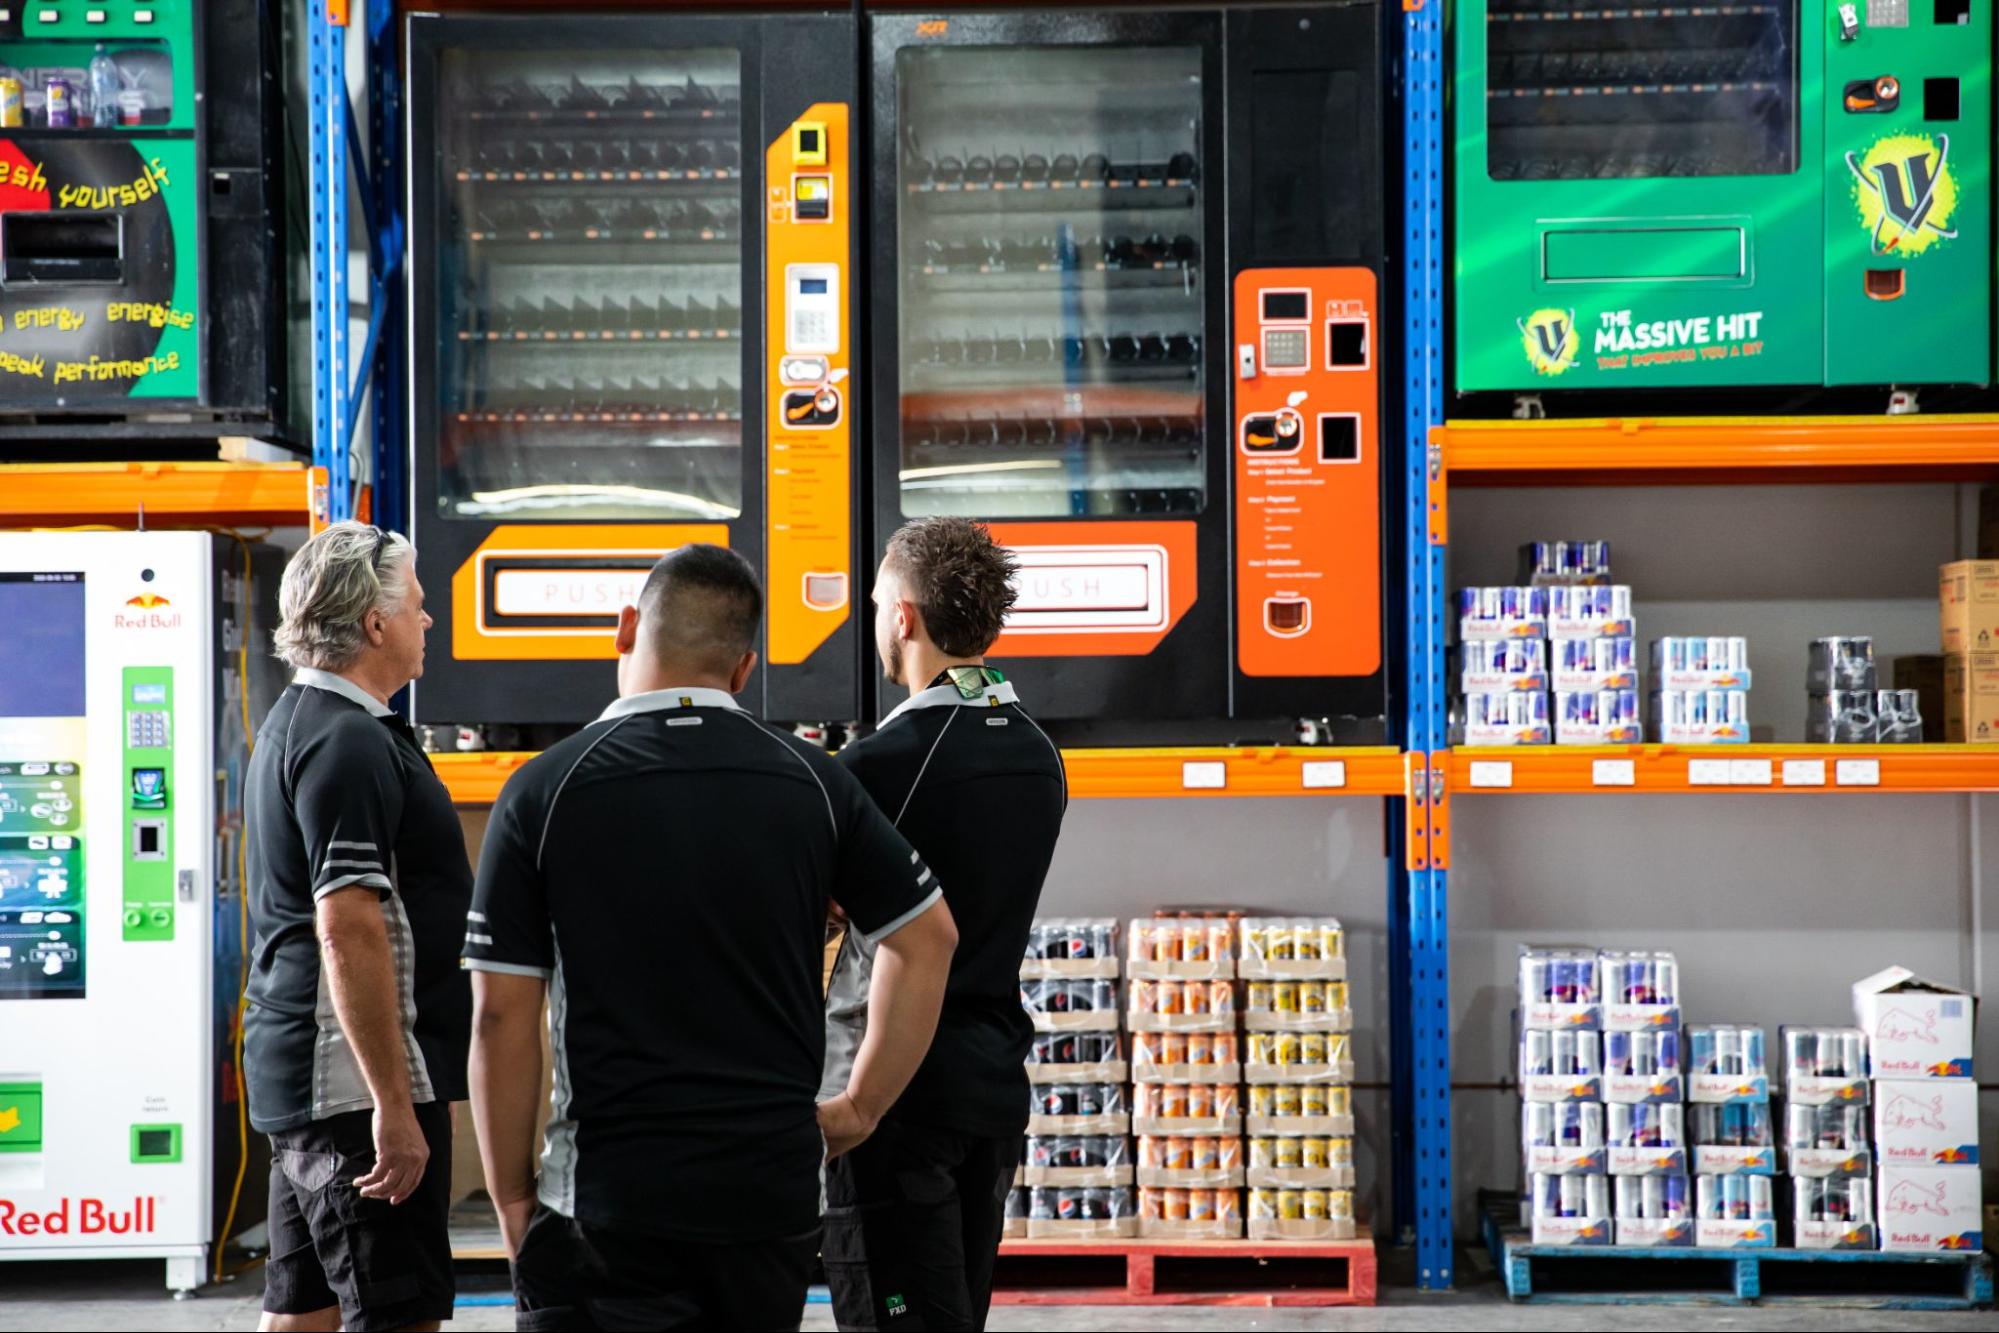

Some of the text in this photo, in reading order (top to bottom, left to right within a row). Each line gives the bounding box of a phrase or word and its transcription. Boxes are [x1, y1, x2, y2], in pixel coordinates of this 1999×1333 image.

[58, 157, 170, 209] yourself
[15, 306, 85, 331] energy
[106, 301, 194, 330] energise
[1600, 309, 1632, 328] THE
[1594, 311, 1763, 354] MASSIVE HIT
[53, 351, 179, 385] performance
[545, 583, 634, 603] PUSH
[114, 614, 181, 628] Red Bull
[0, 1196, 155, 1235] Red Bull
[1891, 1234, 1930, 1243] Red Bull
